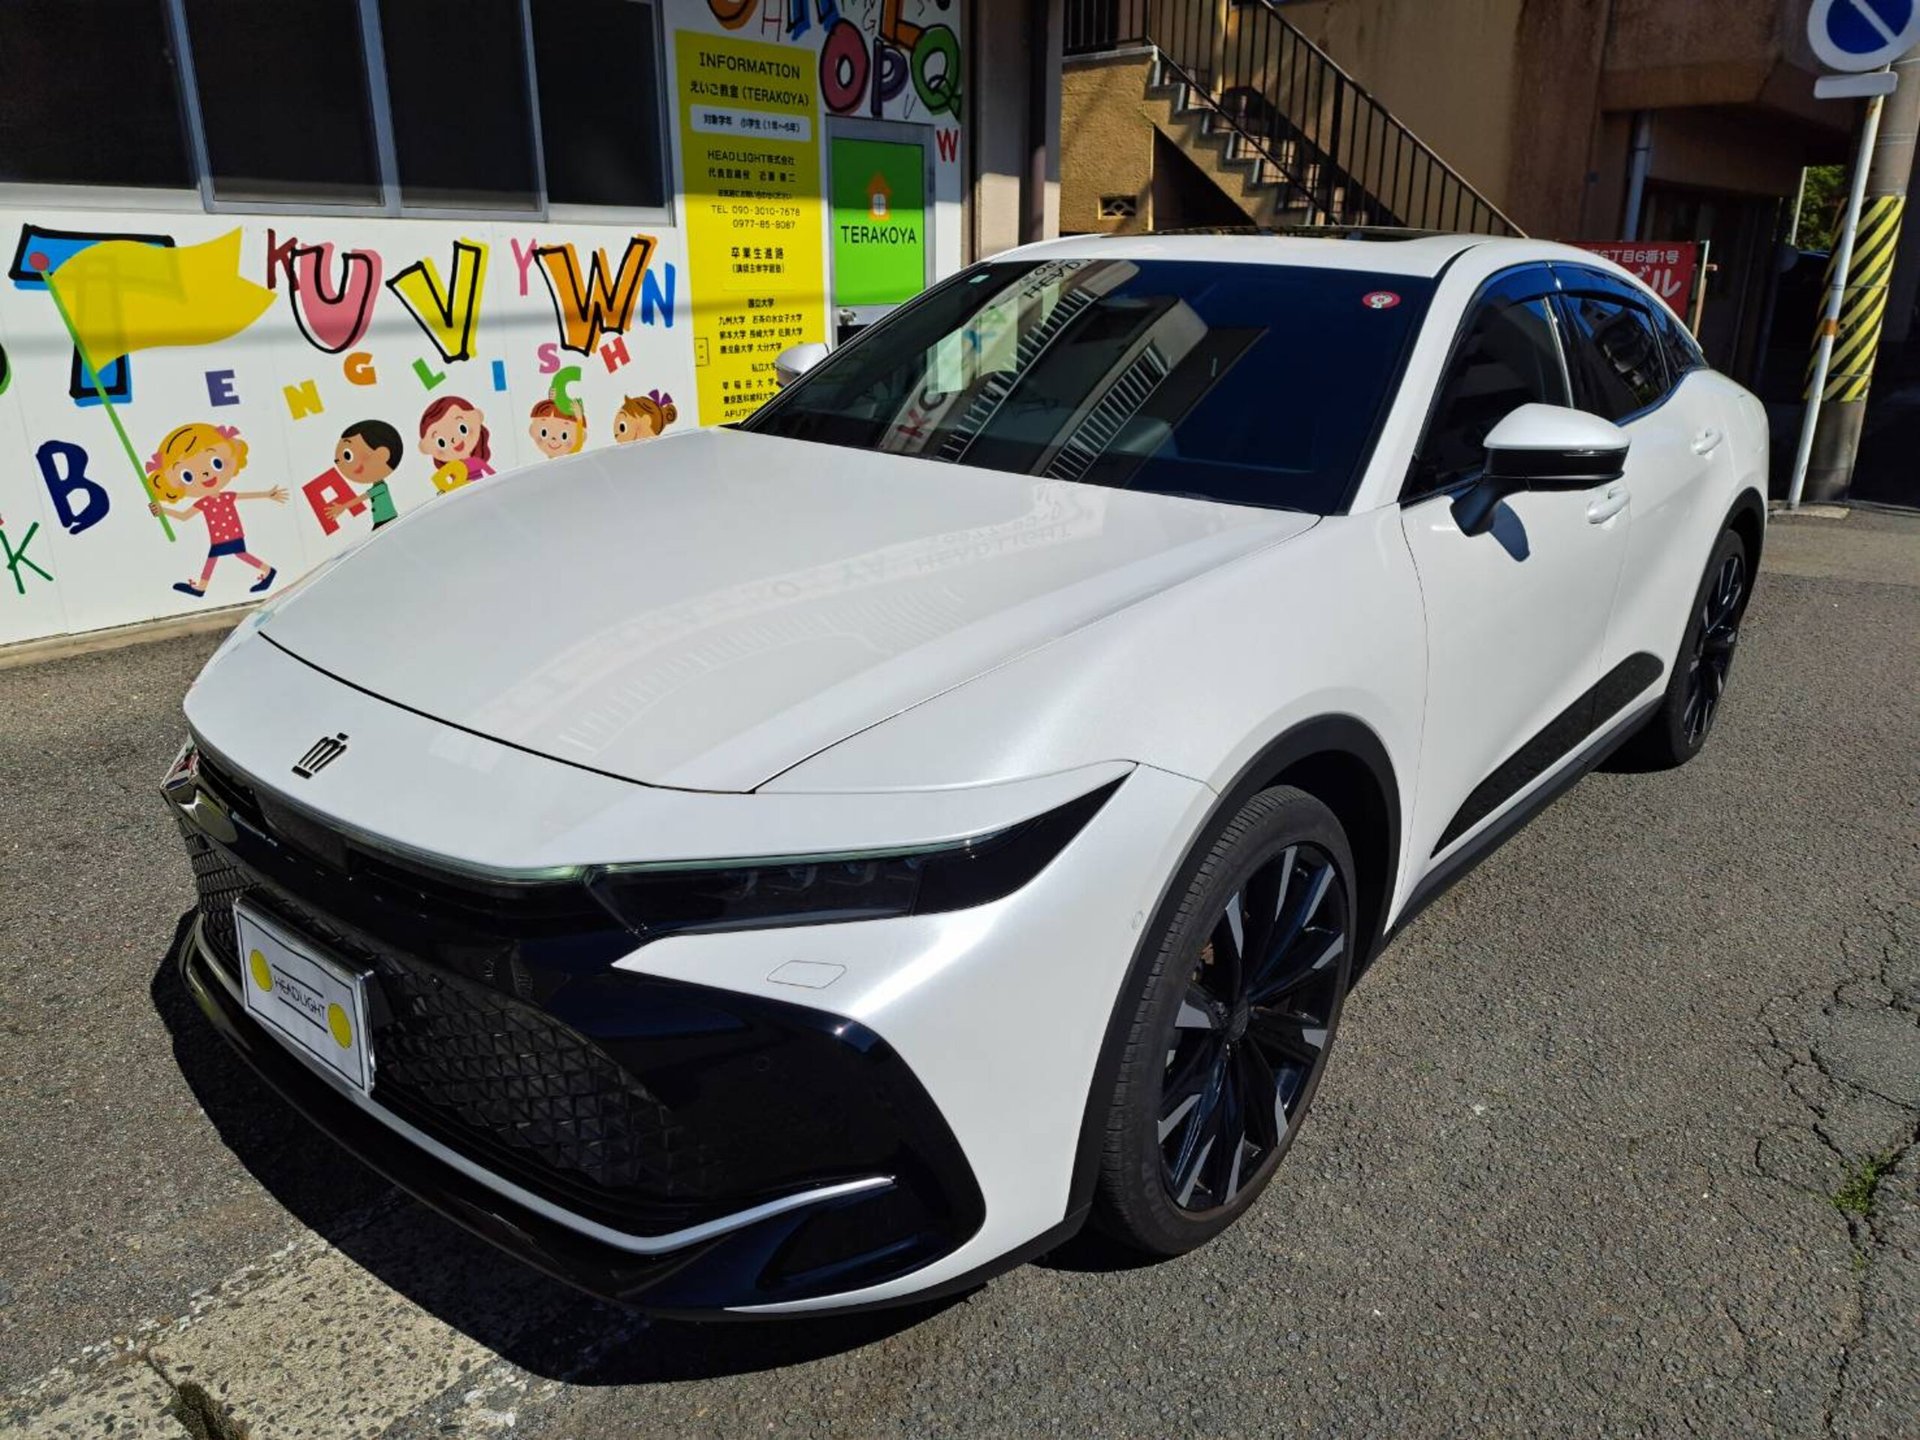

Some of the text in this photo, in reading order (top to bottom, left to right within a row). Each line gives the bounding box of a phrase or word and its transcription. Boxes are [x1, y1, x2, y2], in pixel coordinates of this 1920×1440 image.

[699, 51, 801, 80] INFORMATION
[710, 204, 729, 214] TEL
[840, 225, 918, 245] TERAKOYA
[36, 439, 111, 536] B
[272, 974, 327, 1021] HEADLIGHT
